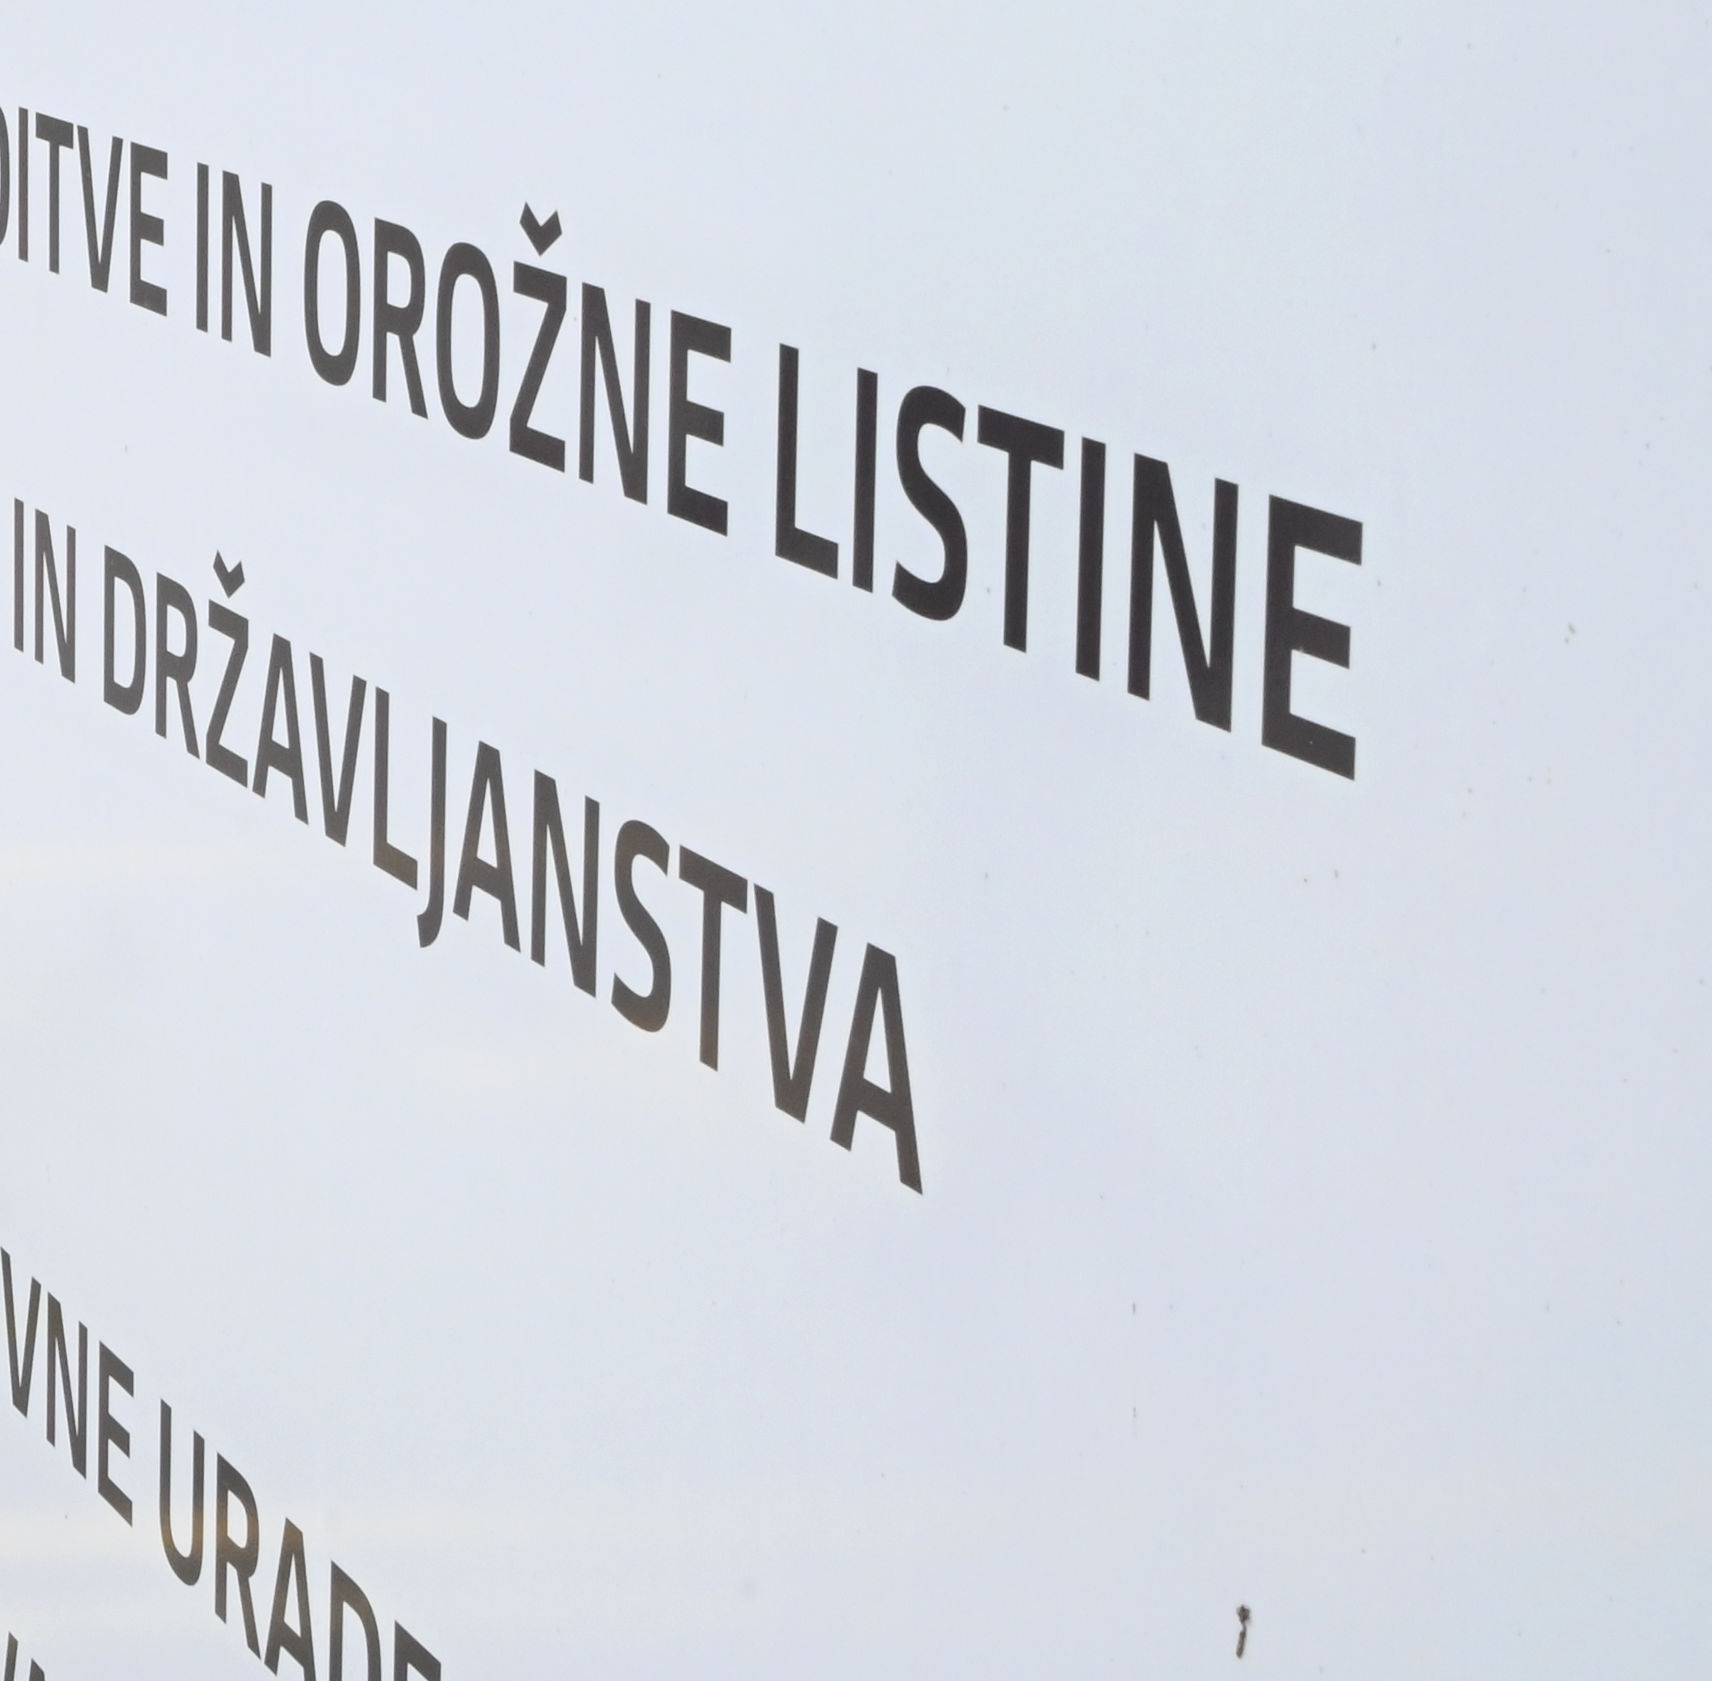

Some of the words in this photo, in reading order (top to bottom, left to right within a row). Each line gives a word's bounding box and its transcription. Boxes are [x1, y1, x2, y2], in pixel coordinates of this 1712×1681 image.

[197, 163, 272, 356] IN
[305, 201, 731, 536] OROŽNE
[776, 344, 1362, 780] LISTINE
[15, 499, 75, 682] IN
[104, 546, 922, 1194] DRŽAVLJANSTVA
